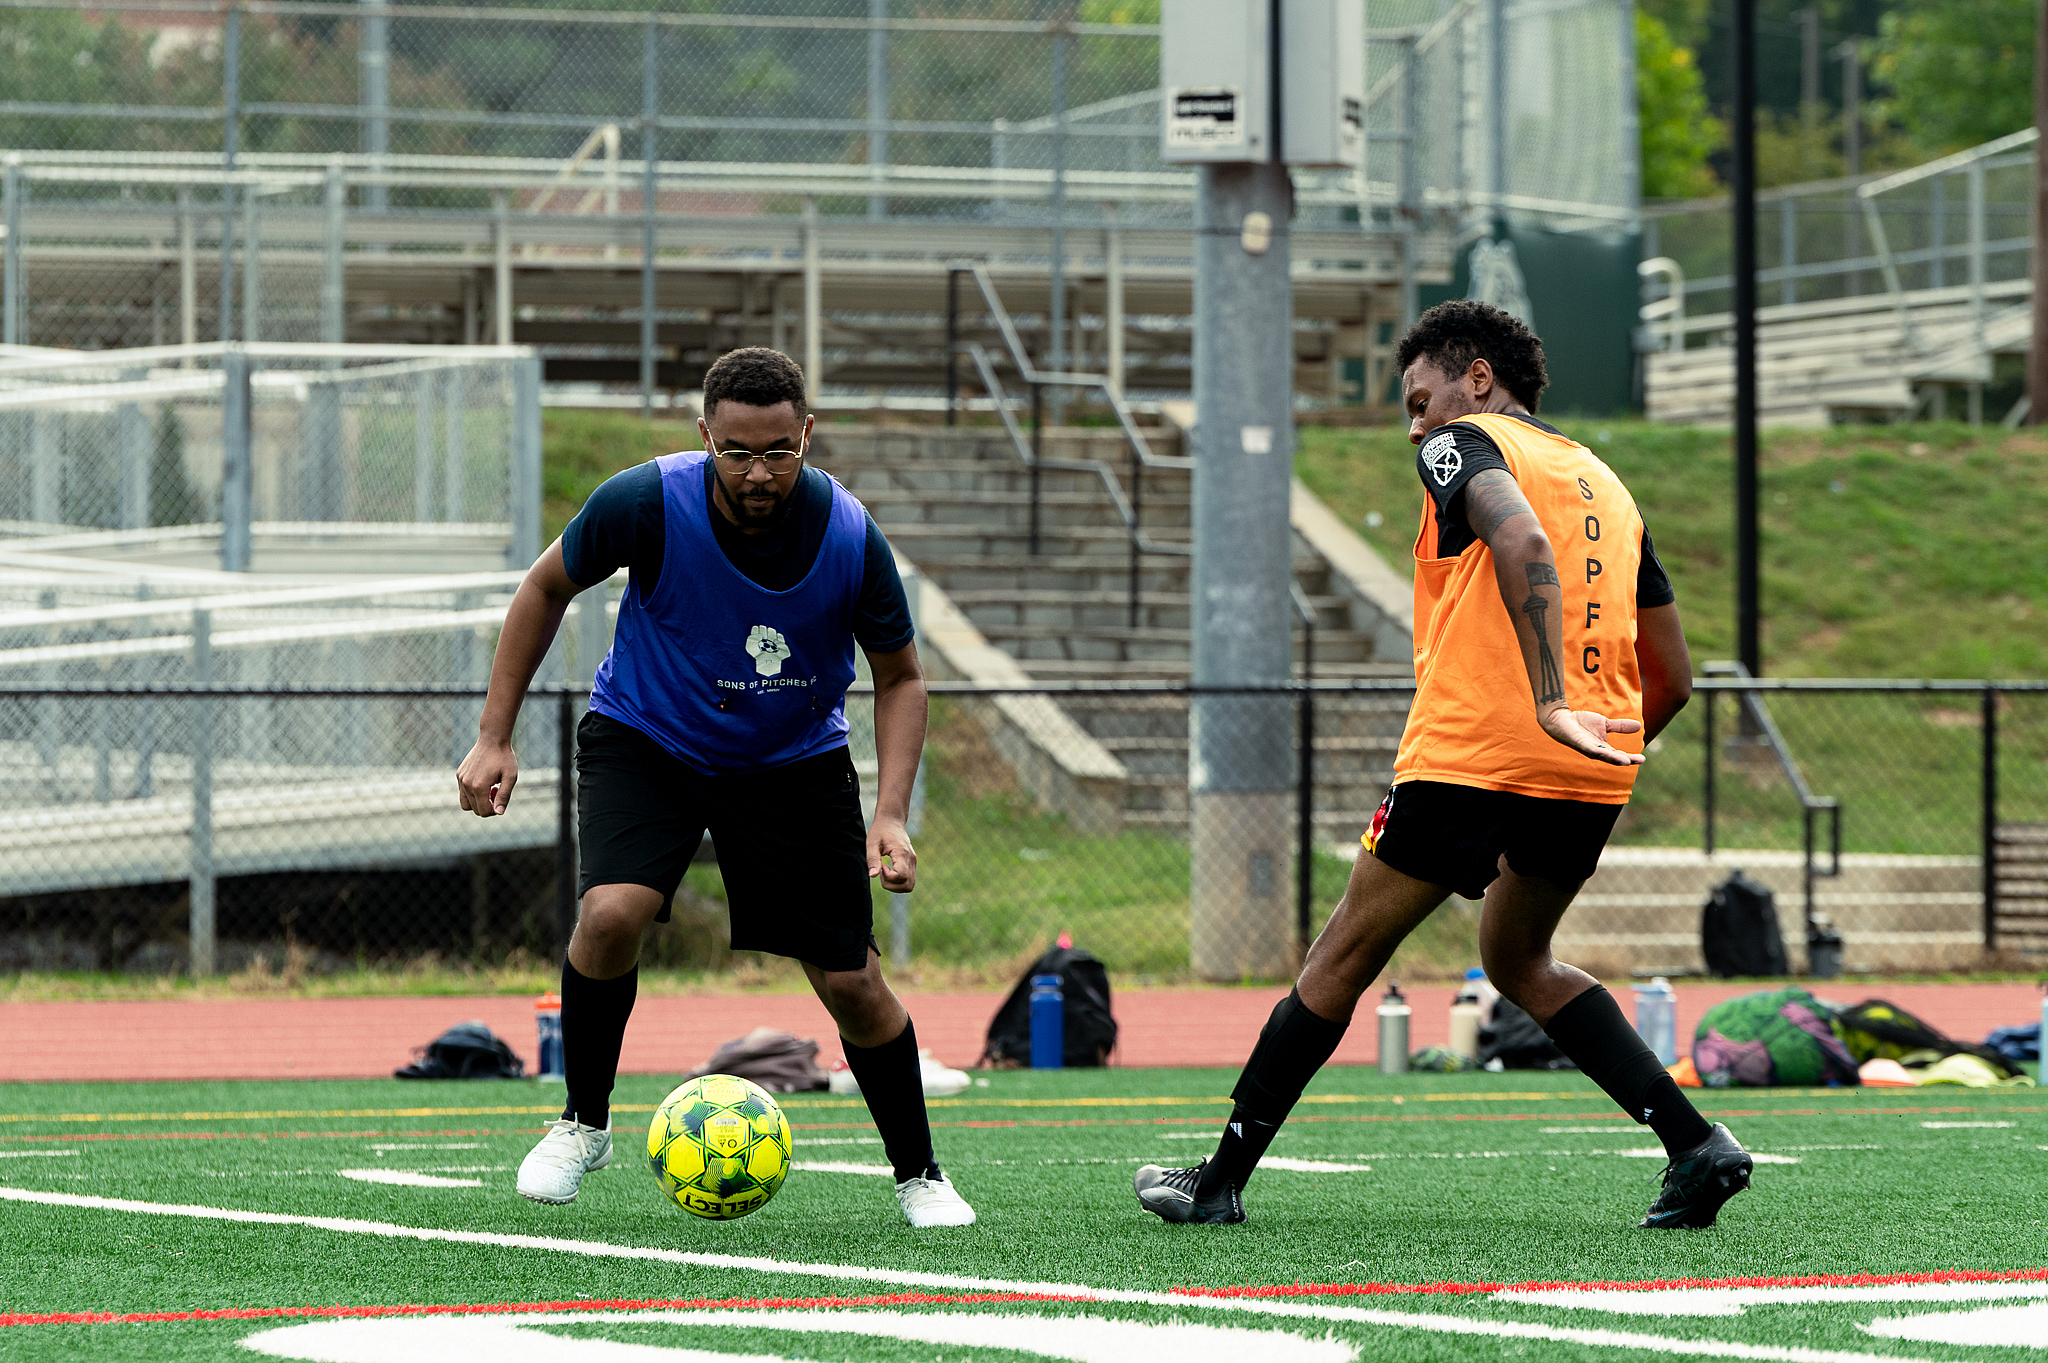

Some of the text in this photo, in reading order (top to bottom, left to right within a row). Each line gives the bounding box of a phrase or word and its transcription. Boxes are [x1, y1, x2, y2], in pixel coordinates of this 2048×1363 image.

[717, 679, 746, 690] SONS
[749, 680, 758, 689] OF
[761, 678, 807, 688] PITCHES
[683, 1193, 763, 1214] SELECT
